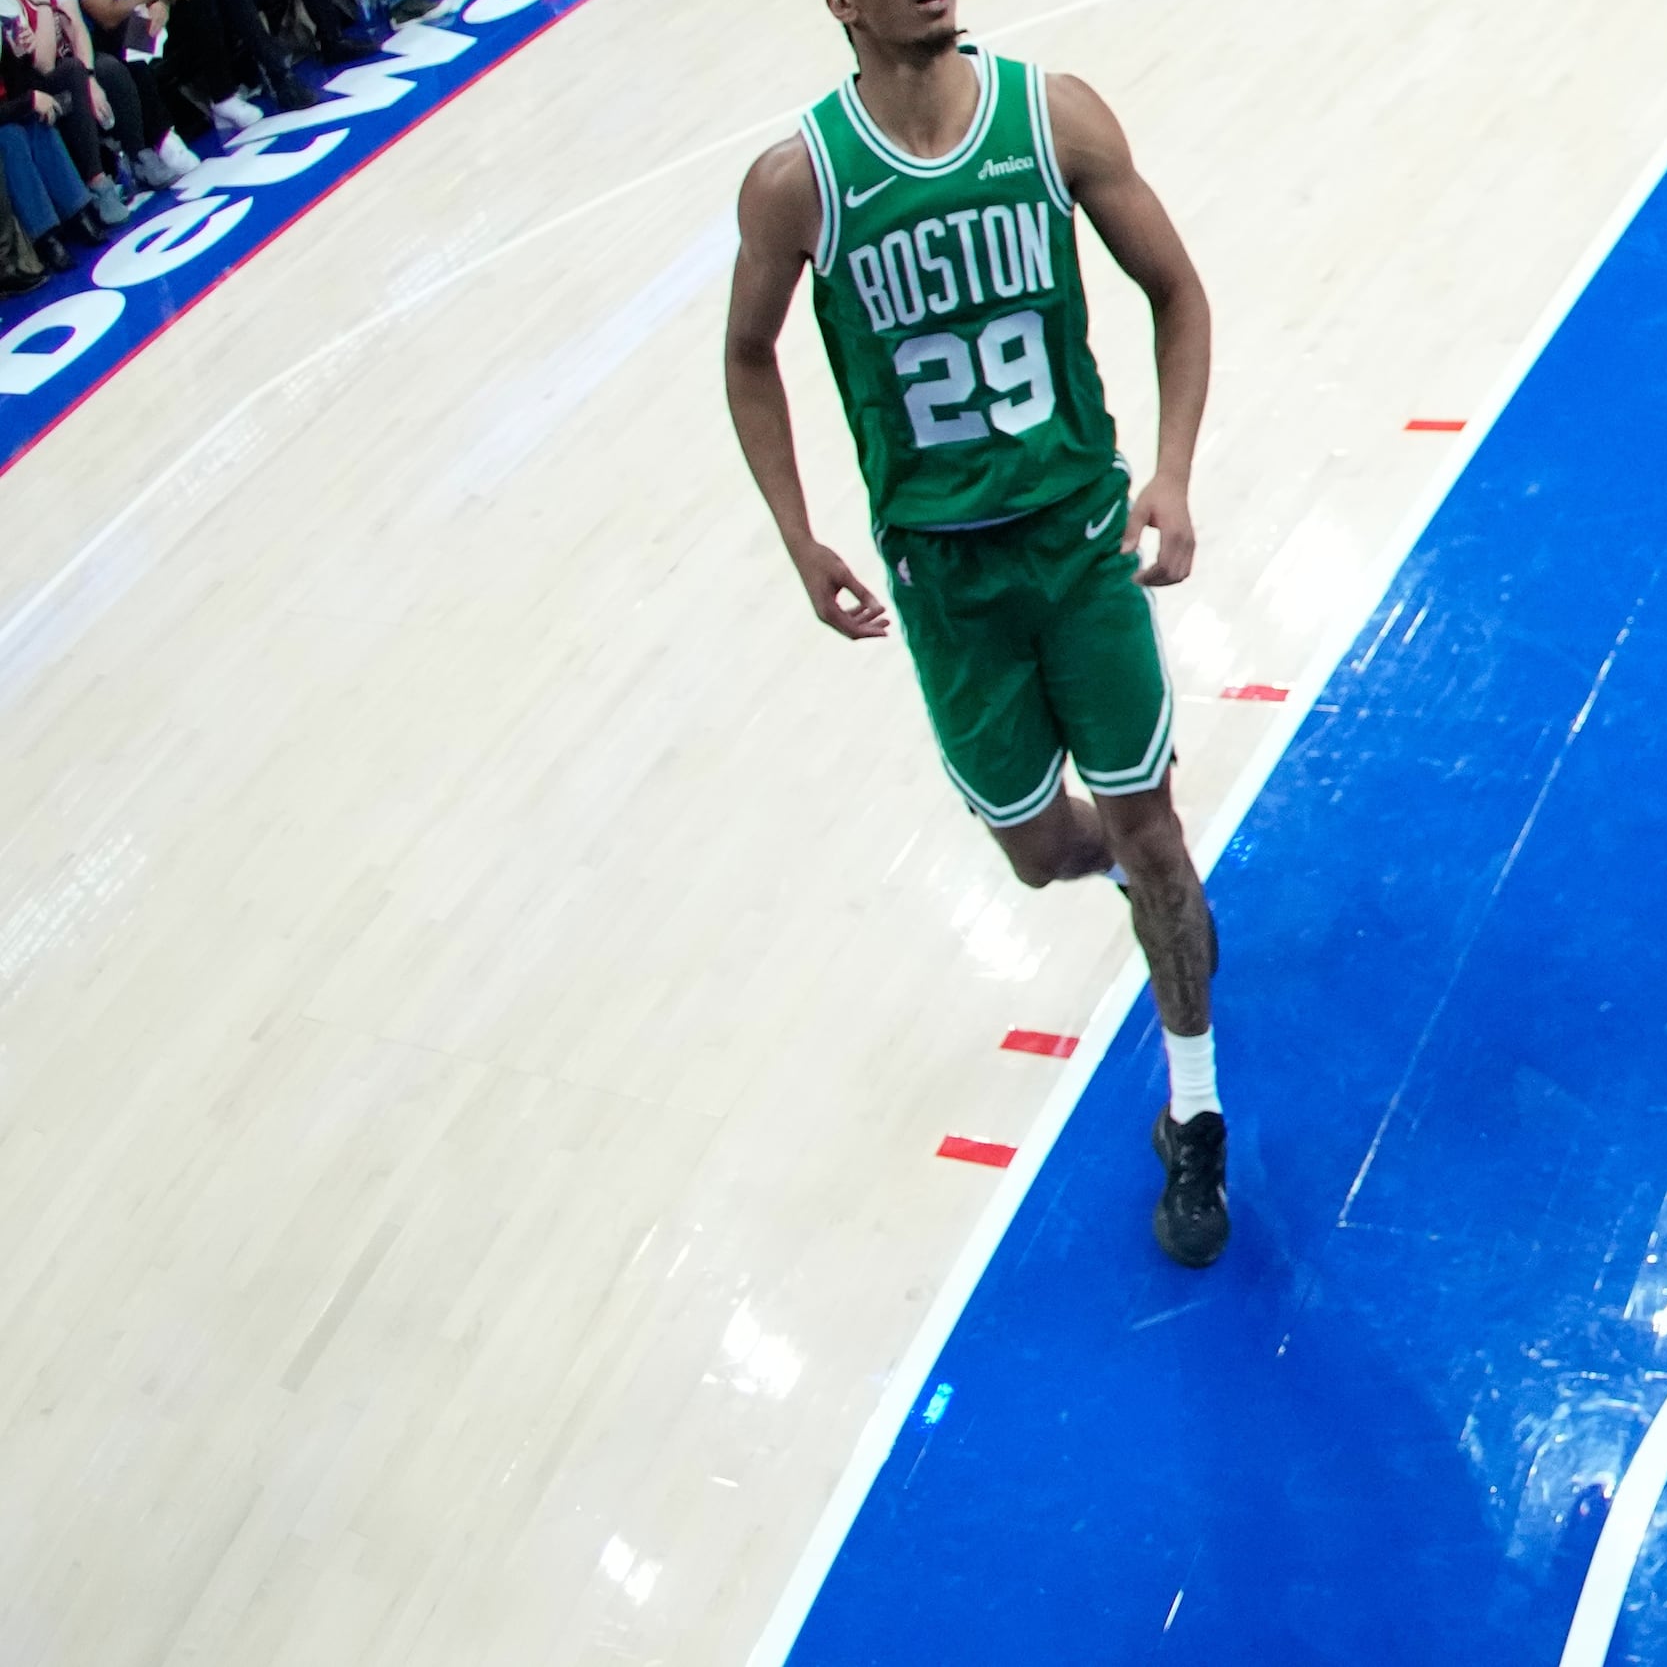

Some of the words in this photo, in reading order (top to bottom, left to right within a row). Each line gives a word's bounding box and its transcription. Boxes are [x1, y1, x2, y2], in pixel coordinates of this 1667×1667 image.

[977, 155, 1035, 182] Amica
[848, 201, 1056, 333] BOSTON
[893, 309, 1057, 449] 29
